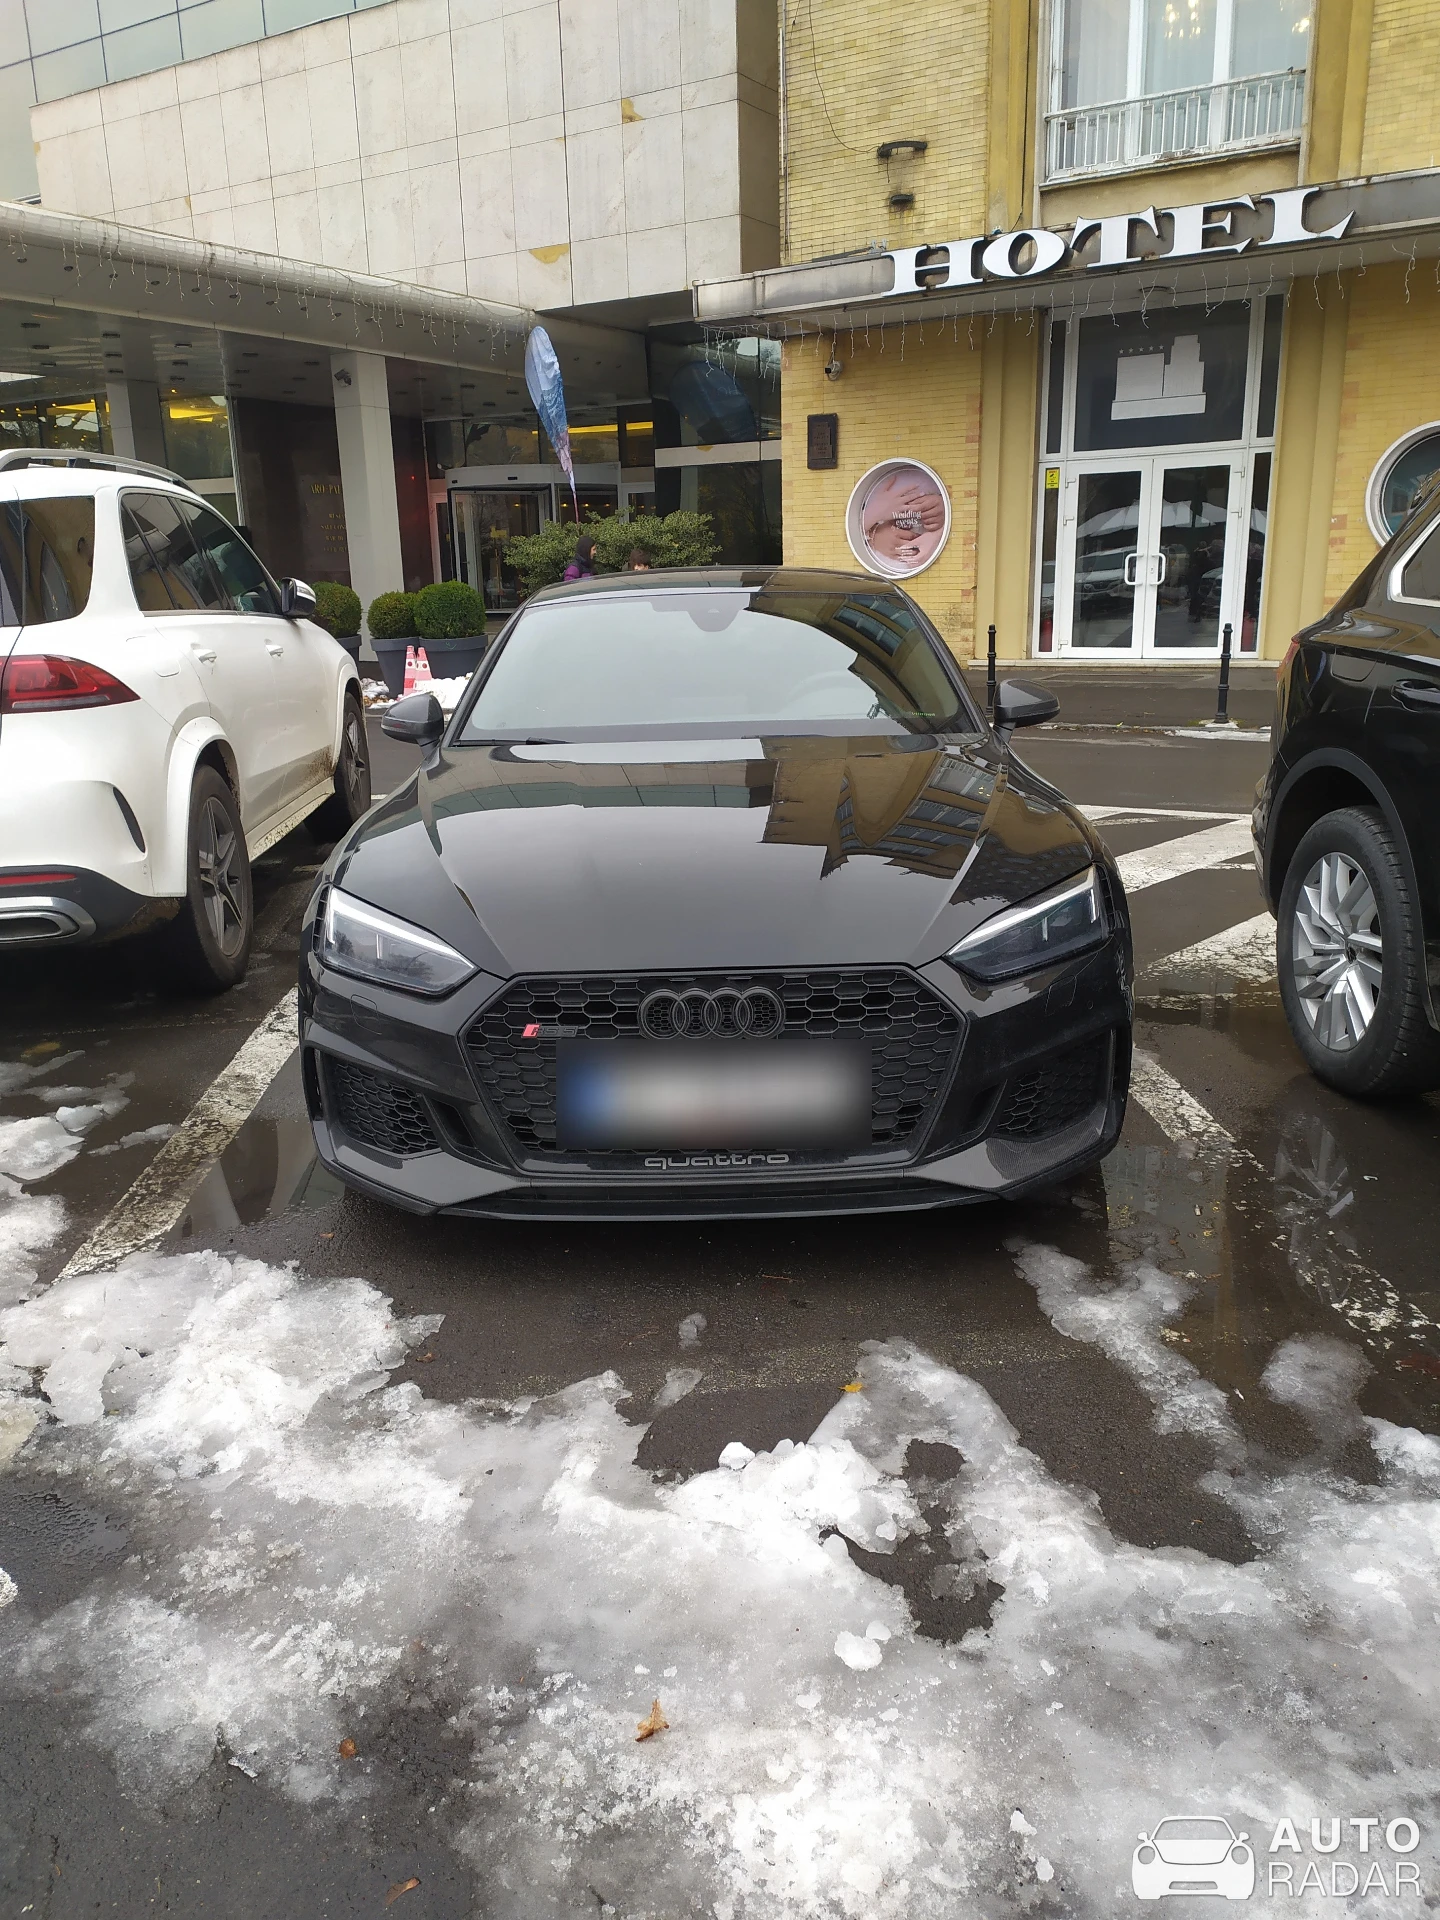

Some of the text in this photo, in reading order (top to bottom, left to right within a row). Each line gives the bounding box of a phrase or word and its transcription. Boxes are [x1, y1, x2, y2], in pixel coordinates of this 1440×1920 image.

[882, 186, 1355, 297] HOTEL
[310, 484, 341, 494] ARO-PAL
[892, 510, 921, 519] Wedding
[895, 518, 918, 526] events
[644, 1153, 790, 1170] quattro
